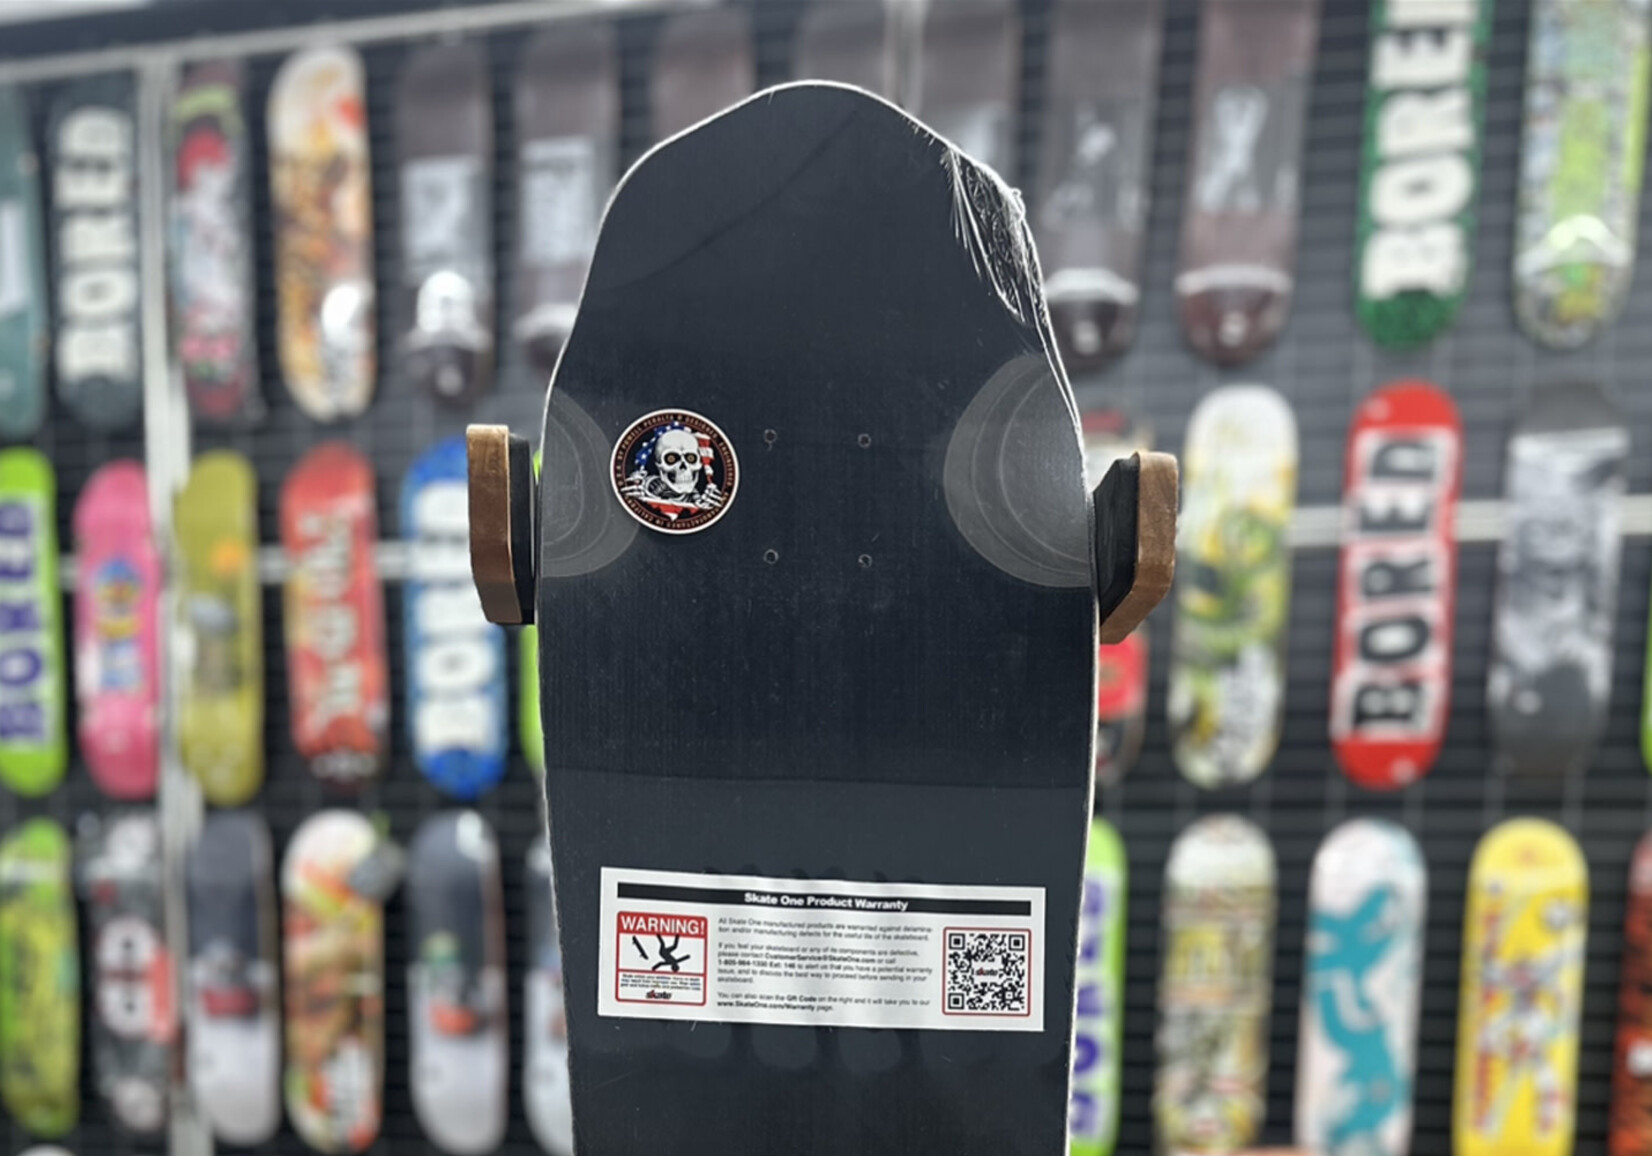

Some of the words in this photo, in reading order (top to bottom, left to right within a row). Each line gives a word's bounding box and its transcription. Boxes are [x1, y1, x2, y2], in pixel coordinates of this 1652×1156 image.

[1366, 0, 1477, 298] BORE
[56, 107, 134, 384] BORED
[1350, 437, 1436, 733] BORED
[621, 915, 705, 935] WARNING!
[744, 892, 778, 905] Skate
[780, 894, 805, 906] One
[807, 895, 852, 907] Product
[855, 897, 909, 911] Warranty
[798, 994, 816, 1002] Code
